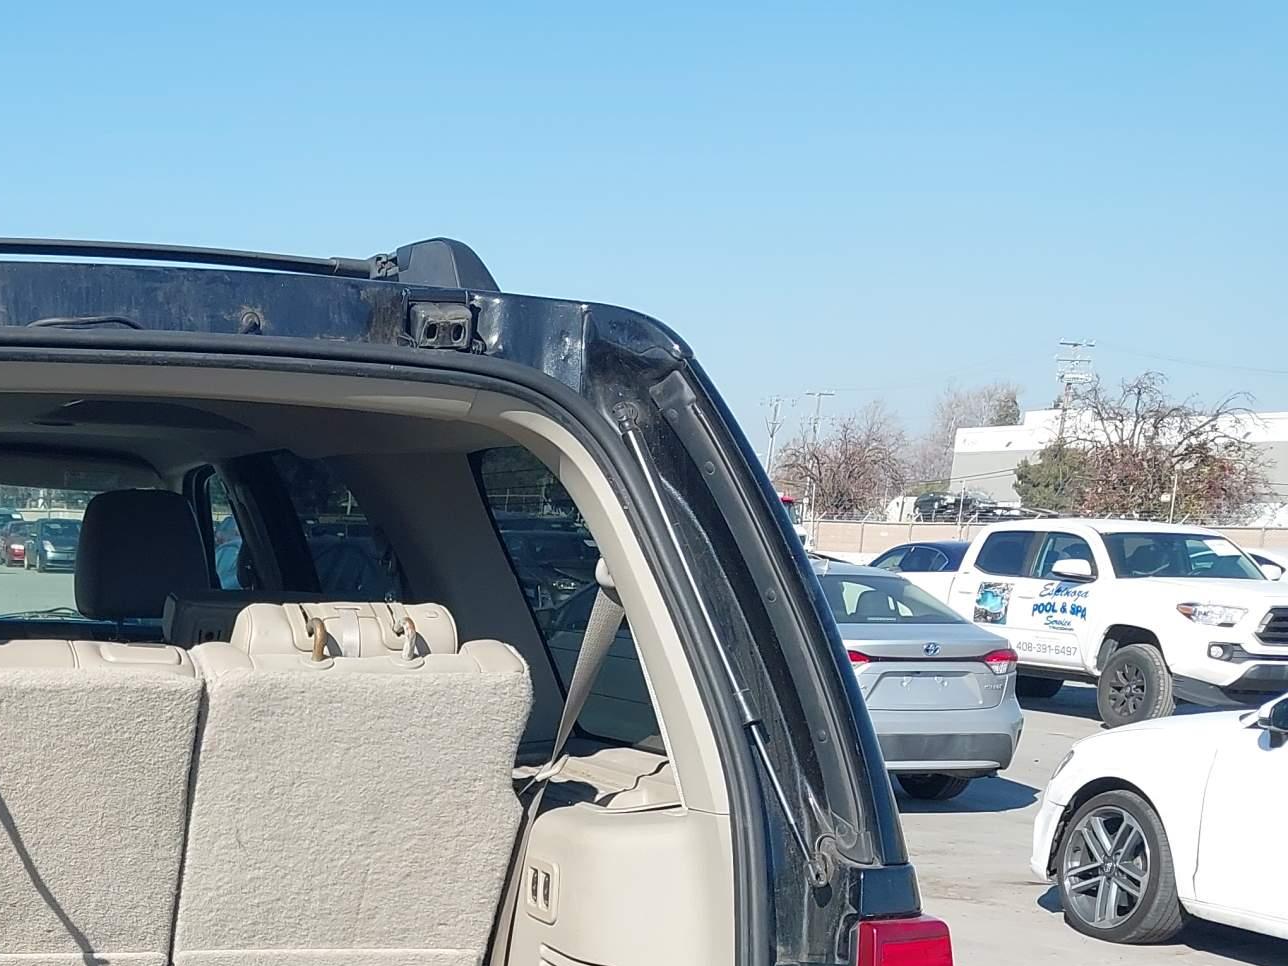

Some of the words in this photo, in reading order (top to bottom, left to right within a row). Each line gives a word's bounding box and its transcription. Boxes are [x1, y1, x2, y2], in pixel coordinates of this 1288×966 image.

[1032, 602, 1057, 616] POOL
[1060, 602, 1067, 613] &
[1070, 603, 1086, 621] SPA
[1044, 616, 1072, 625] Service
[1016, 641, 1078, 656] 408-391-6497
